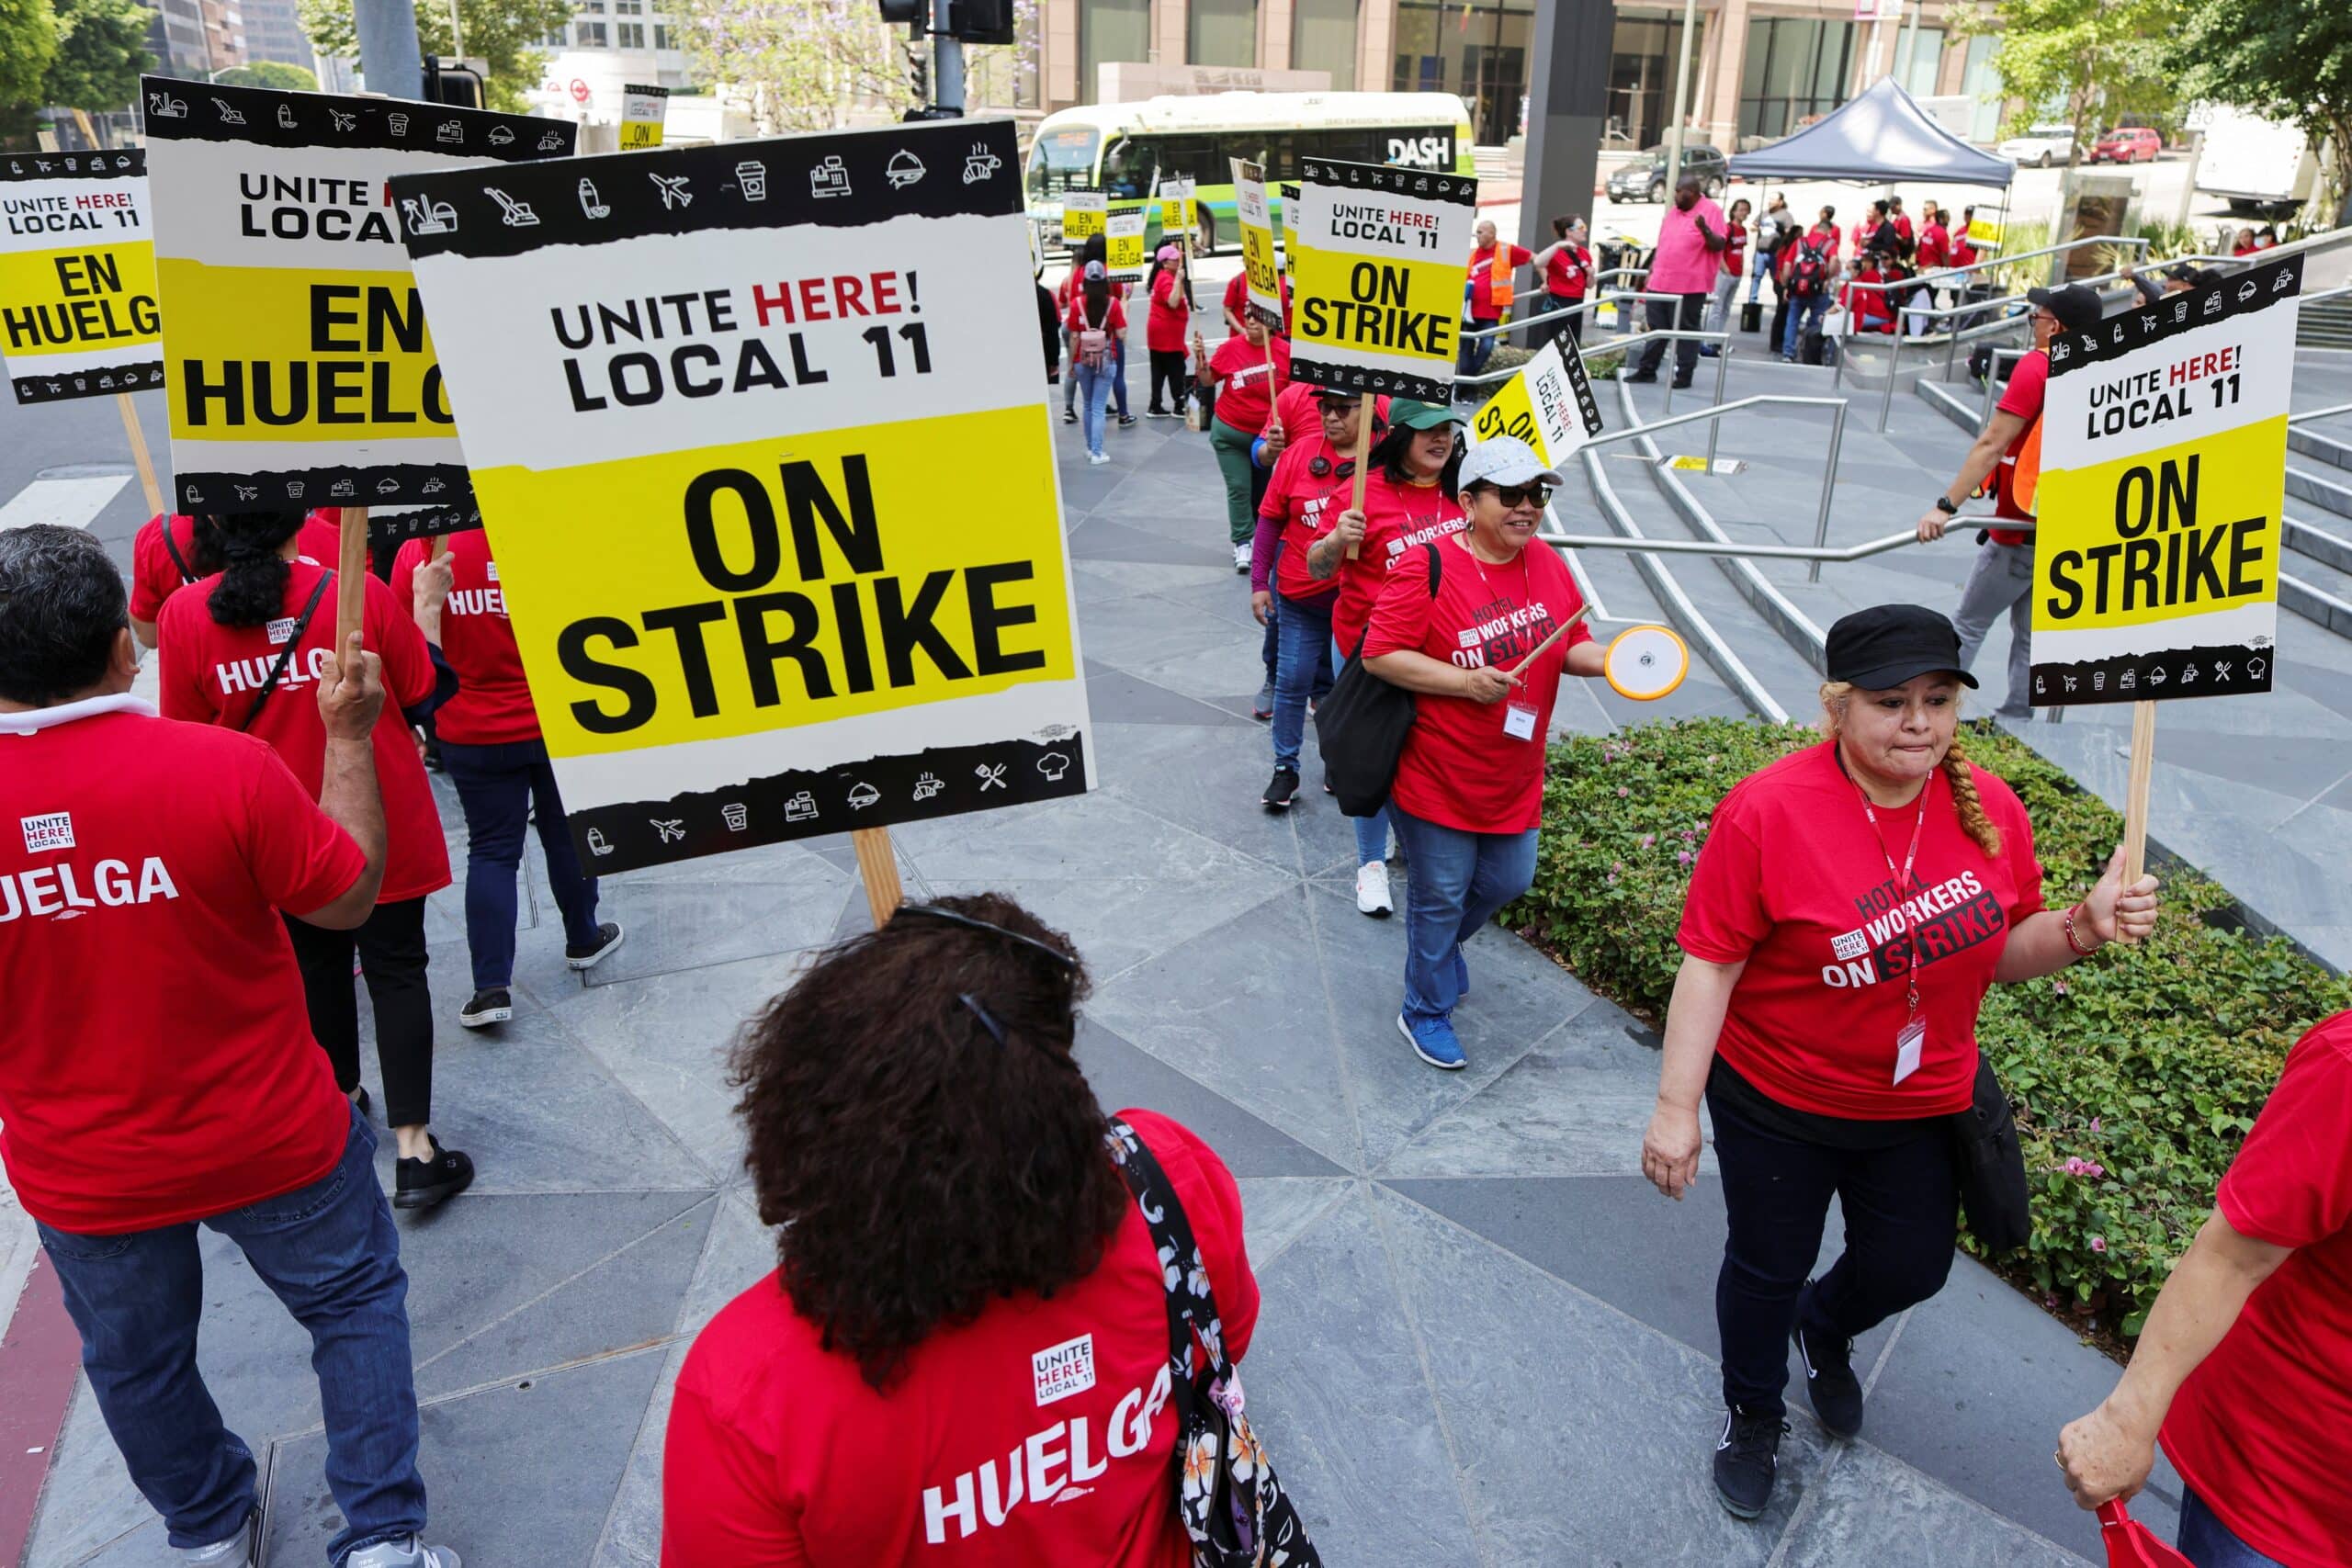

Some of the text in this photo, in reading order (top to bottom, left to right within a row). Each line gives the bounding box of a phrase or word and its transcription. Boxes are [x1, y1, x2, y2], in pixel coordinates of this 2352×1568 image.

[634, 124, 650, 142] ON
[1387, 137, 1449, 166] DASH
[4, 193, 134, 214] UNITE HERE!
[240, 173, 369, 207] UNITE
[8, 209, 141, 235] LOCAL 11
[241, 204, 395, 244] LOCA
[1079, 212, 1093, 224] EN
[1333, 203, 1440, 229] UNITE HERE!
[1118, 239, 1130, 253] EN
[1248, 229, 1261, 259] EN
[1330, 215, 1439, 249] LOCAL 11
[1108, 253, 1143, 267] HUELGA
[53, 253, 123, 298] EN
[1351, 262, 1410, 308] ON
[2, 295, 161, 348] HUELG
[310, 284, 424, 354] EN
[551, 270, 922, 350] UNITE HERE!
[1302, 296, 1450, 356] STRIKE
[562, 321, 932, 412] LOCAL 11
[2089, 344, 2242, 408] UNITE HERE!
[1536, 374, 1566, 445] LOCAL 11
[1546, 367, 1573, 434] UNITE HERE!
[2086, 373, 2241, 440] LOCAL 11
[2114, 453, 2200, 539] ON
[683, 452, 887, 593] ON
[1301, 513, 1320, 528] ON
[1403, 517, 1467, 547] WORKERS
[2046, 516, 2267, 620] STRIKE
[447, 588, 509, 615] HUEL
[1472, 596, 1519, 623] HOTEL
[267, 620, 295, 630] UNITE
[269, 627, 293, 637] HERE
[557, 558, 1047, 735] STRIKE
[1452, 647, 1486, 669] ON
[216, 648, 323, 694] HUELG
[25, 816, 70, 831] UNITE
[27, 827, 71, 841] HERE!
[28, 839, 62, 849] LOCAL
[0, 856, 180, 923] UELGA
[1865, 870, 1984, 946] WORKERS
[1833, 931, 1863, 948] UNITE
[1836, 939, 1866, 953] HERE!
[1838, 950, 1860, 960] LOCAL
[1822, 957, 1877, 988] ON
[1036, 1342, 1091, 1372] UNITE
[1037, 1357, 1091, 1388] HERE!
[1039, 1371, 1093, 1399] LOCAL 11
[922, 1361, 1172, 1545] HUELGA
